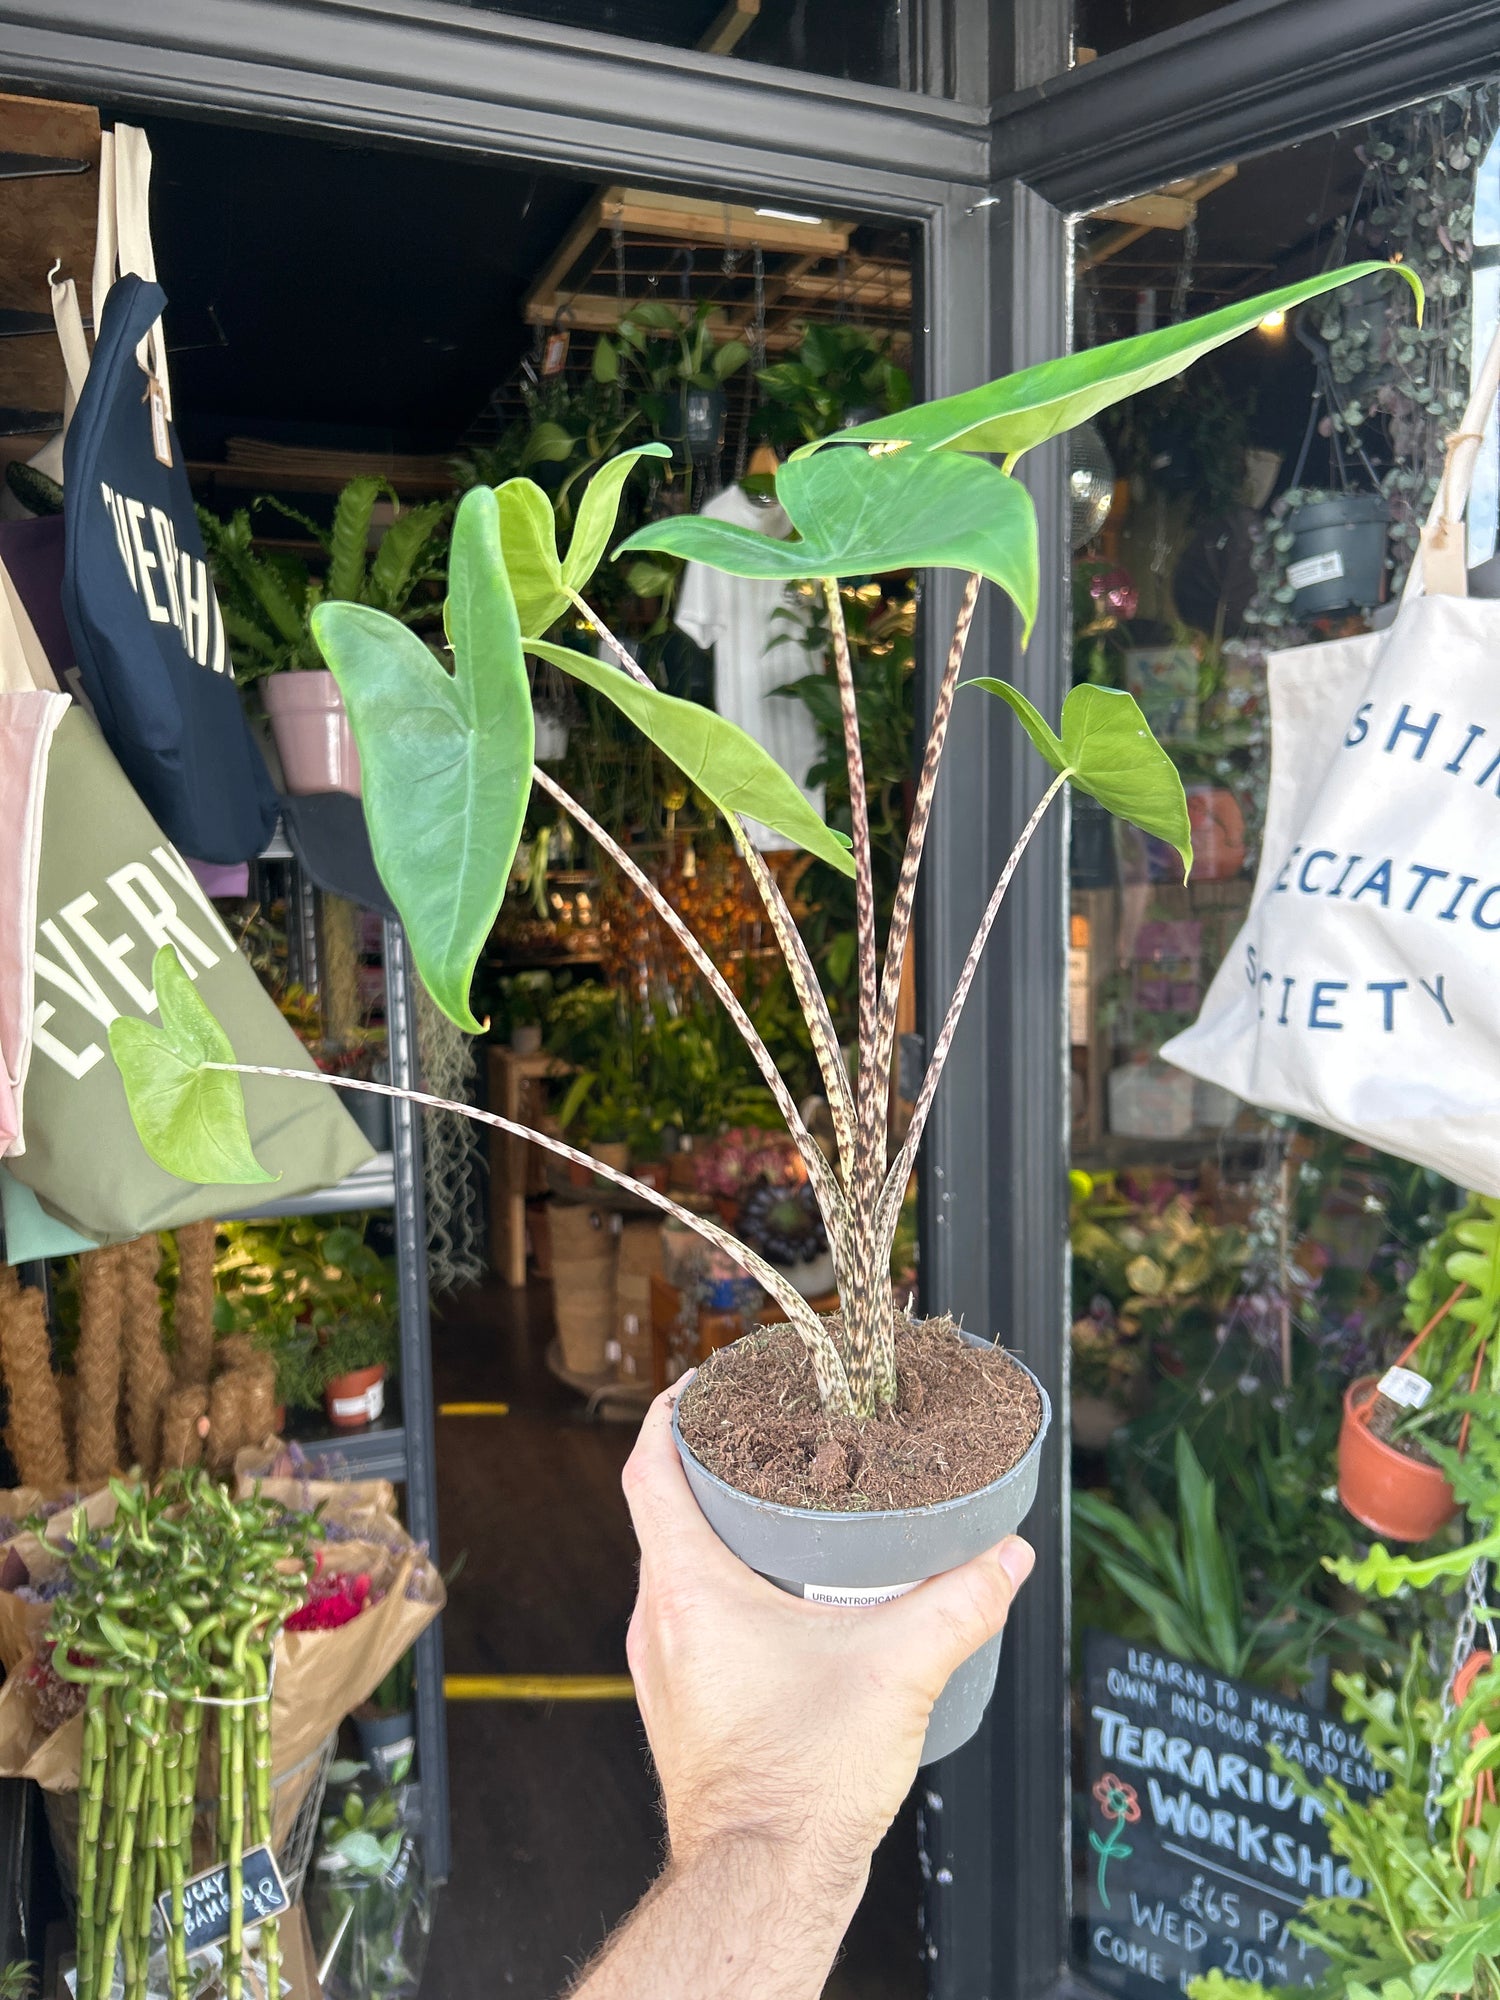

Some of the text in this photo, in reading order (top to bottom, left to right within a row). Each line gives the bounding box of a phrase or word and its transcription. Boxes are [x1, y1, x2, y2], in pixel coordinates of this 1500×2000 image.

[812, 1592, 904, 1605] URBANTROPICAN
[1107, 1667, 1157, 1708] OWN
[1171, 1692, 1263, 1748] INDOOR
[1128, 1648, 1373, 1763] LEARN TO MAKE YOU
[1147, 1777, 1374, 1900] WORKSHO
[182, 1872, 225, 1910] UCKY
[1130, 1890, 1208, 1952] WED
[1179, 1874, 1241, 1928] £65
[1093, 1925, 1167, 1984] COME
